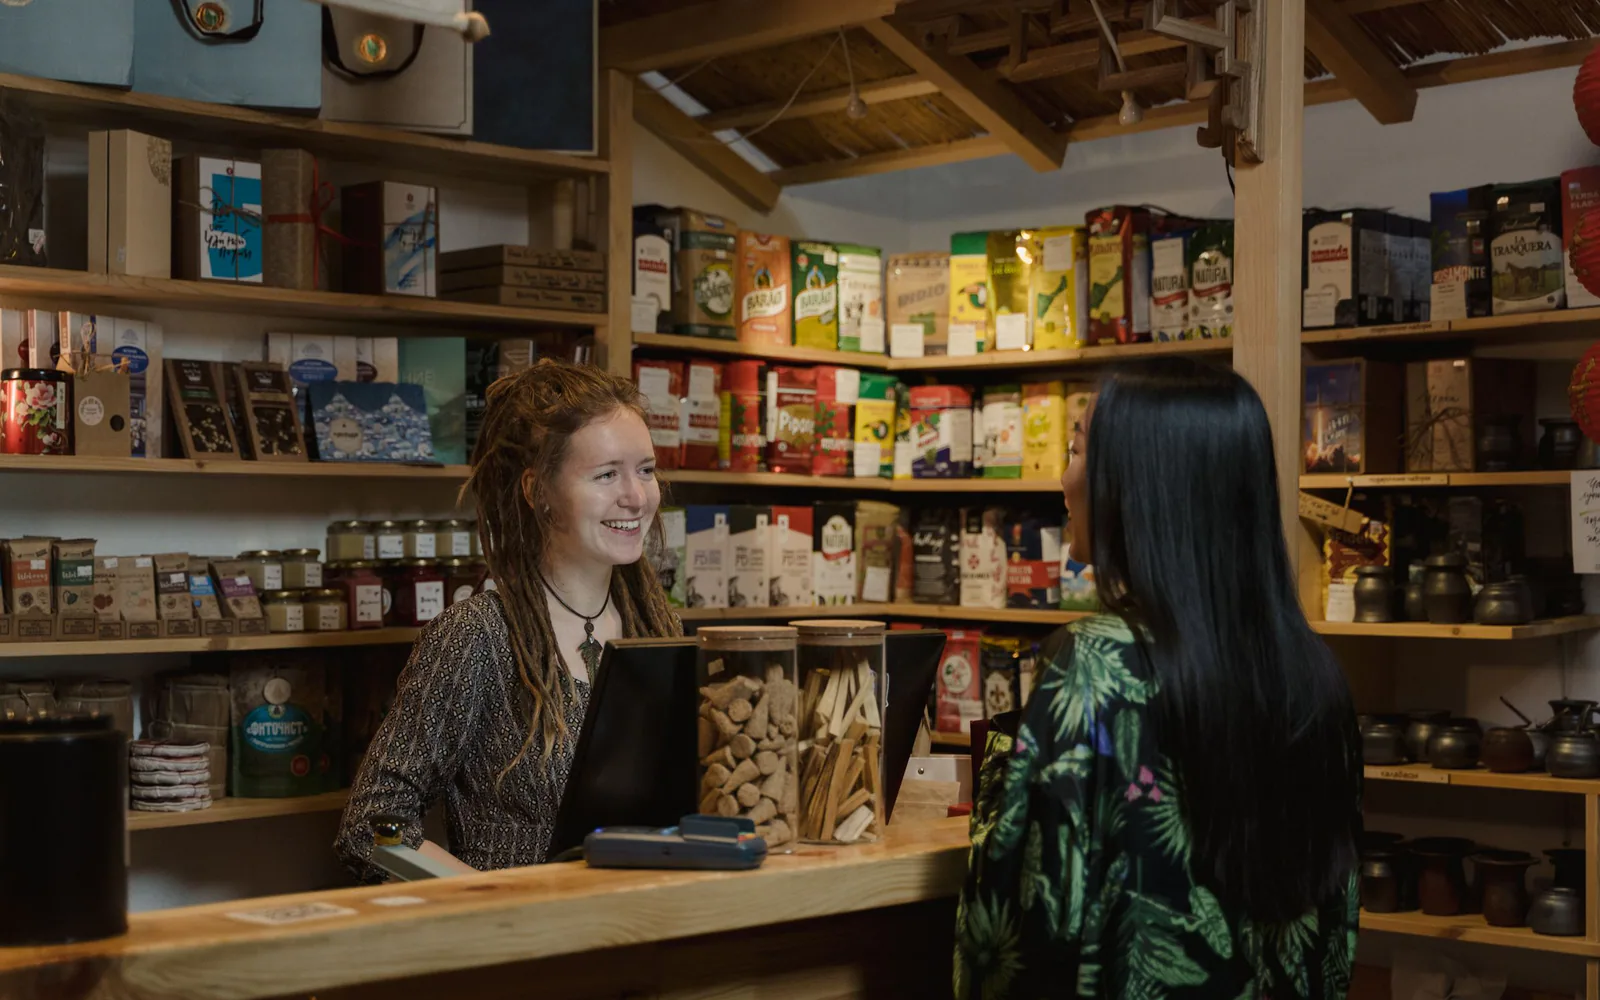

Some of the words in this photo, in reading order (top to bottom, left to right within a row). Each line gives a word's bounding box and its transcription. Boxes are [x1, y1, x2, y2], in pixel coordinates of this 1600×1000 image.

[1514, 236, 1525, 244] LA
[1493, 242, 1552, 257] TRANQUERA
[1195, 267, 1227, 284] NATURA
[1433, 265, 1486, 283] ROSAMONTE
[1153, 275, 1185, 291] NATURA
